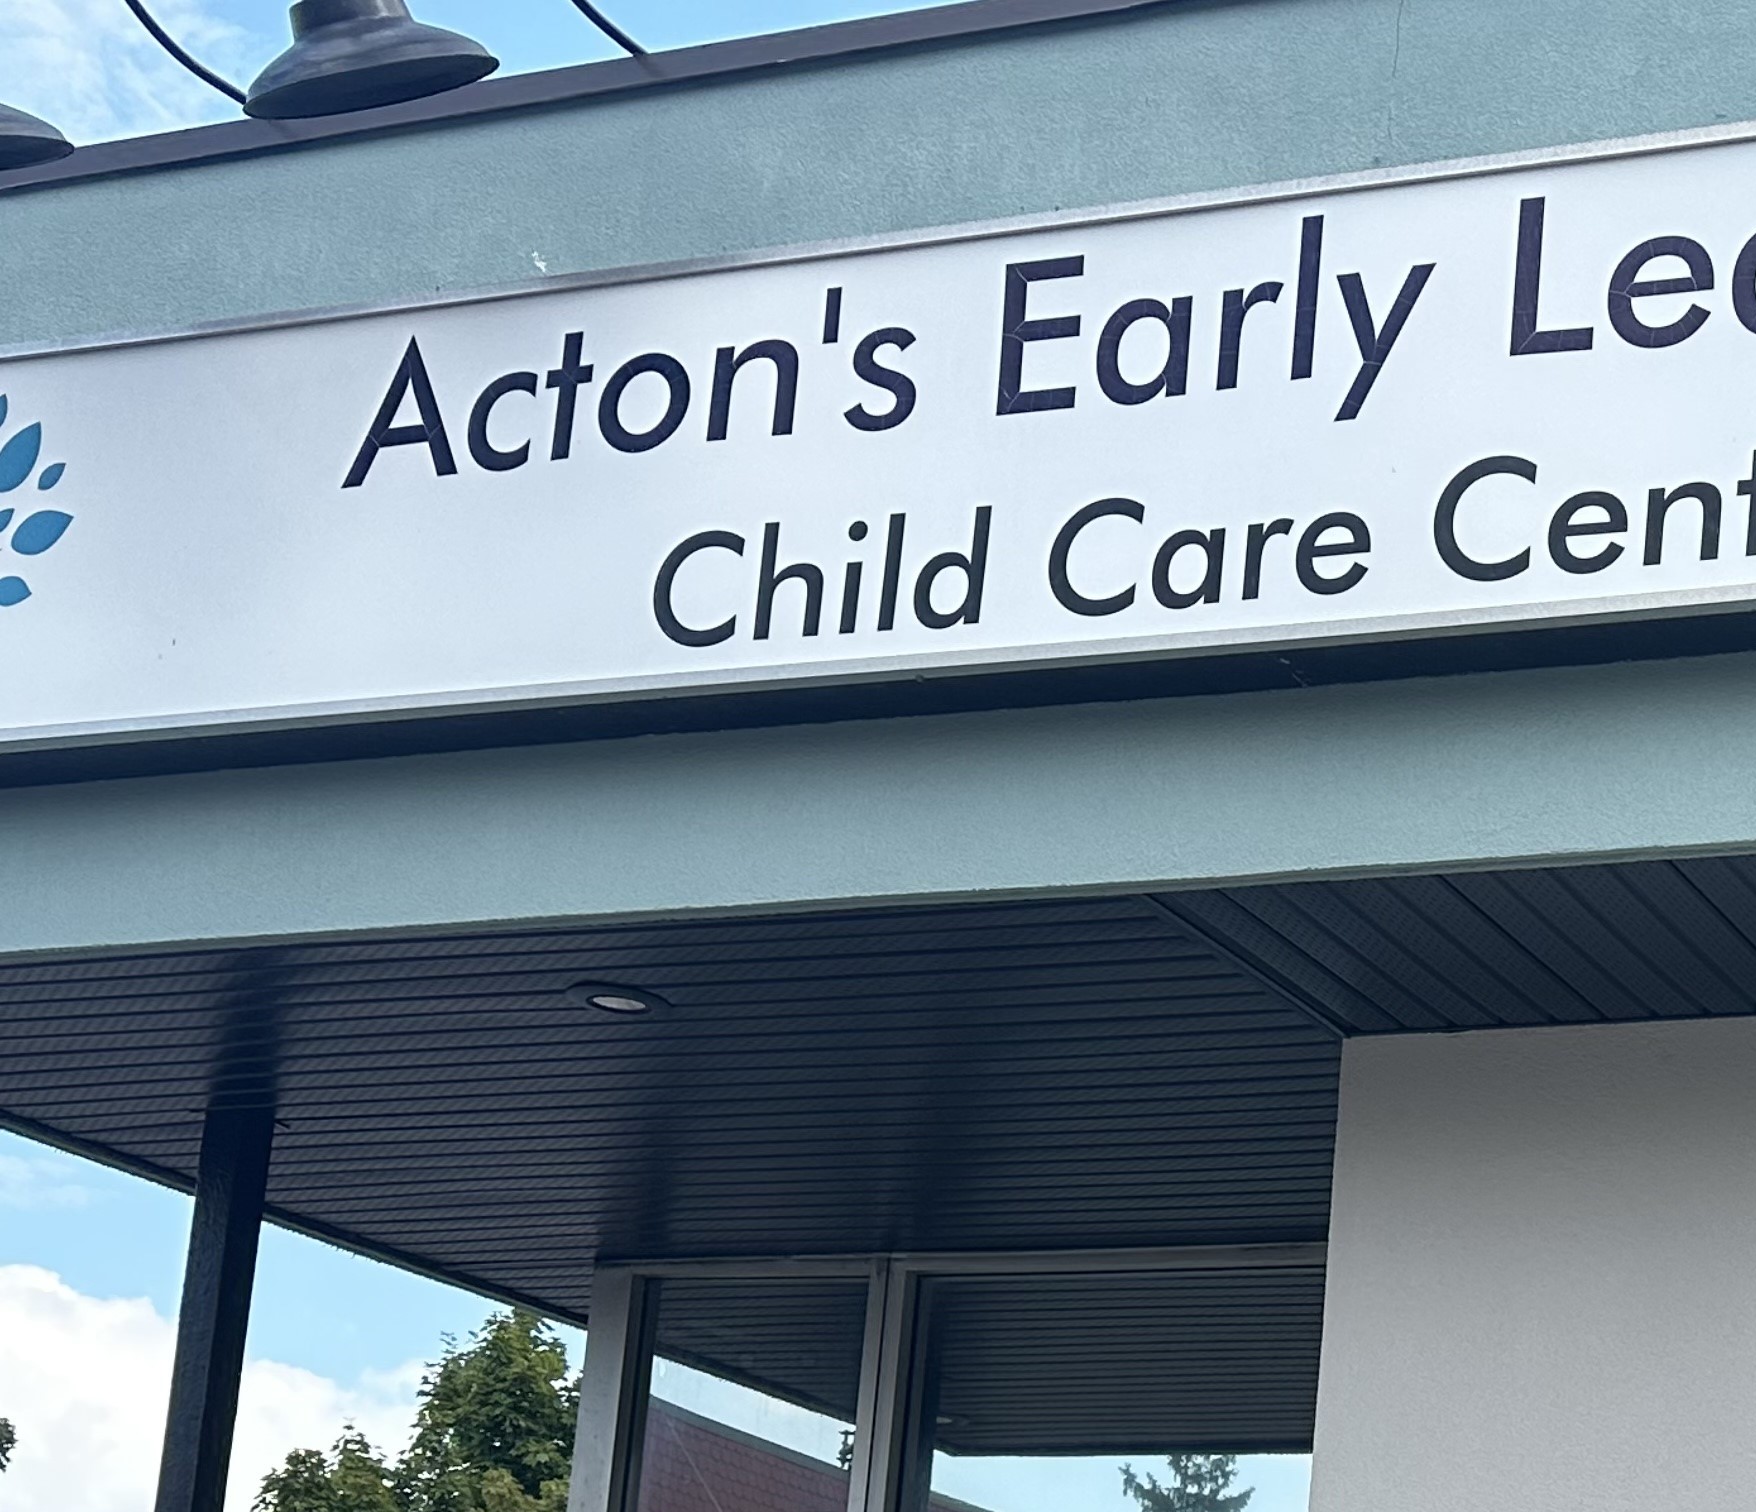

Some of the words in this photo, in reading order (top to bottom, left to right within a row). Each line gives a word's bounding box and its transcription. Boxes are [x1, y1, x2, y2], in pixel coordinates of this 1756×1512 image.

[341, 286, 917, 489] Acton's
[995, 214, 1437, 422] Early
[652, 505, 992, 648] Child
[1047, 498, 1371, 617] Care
